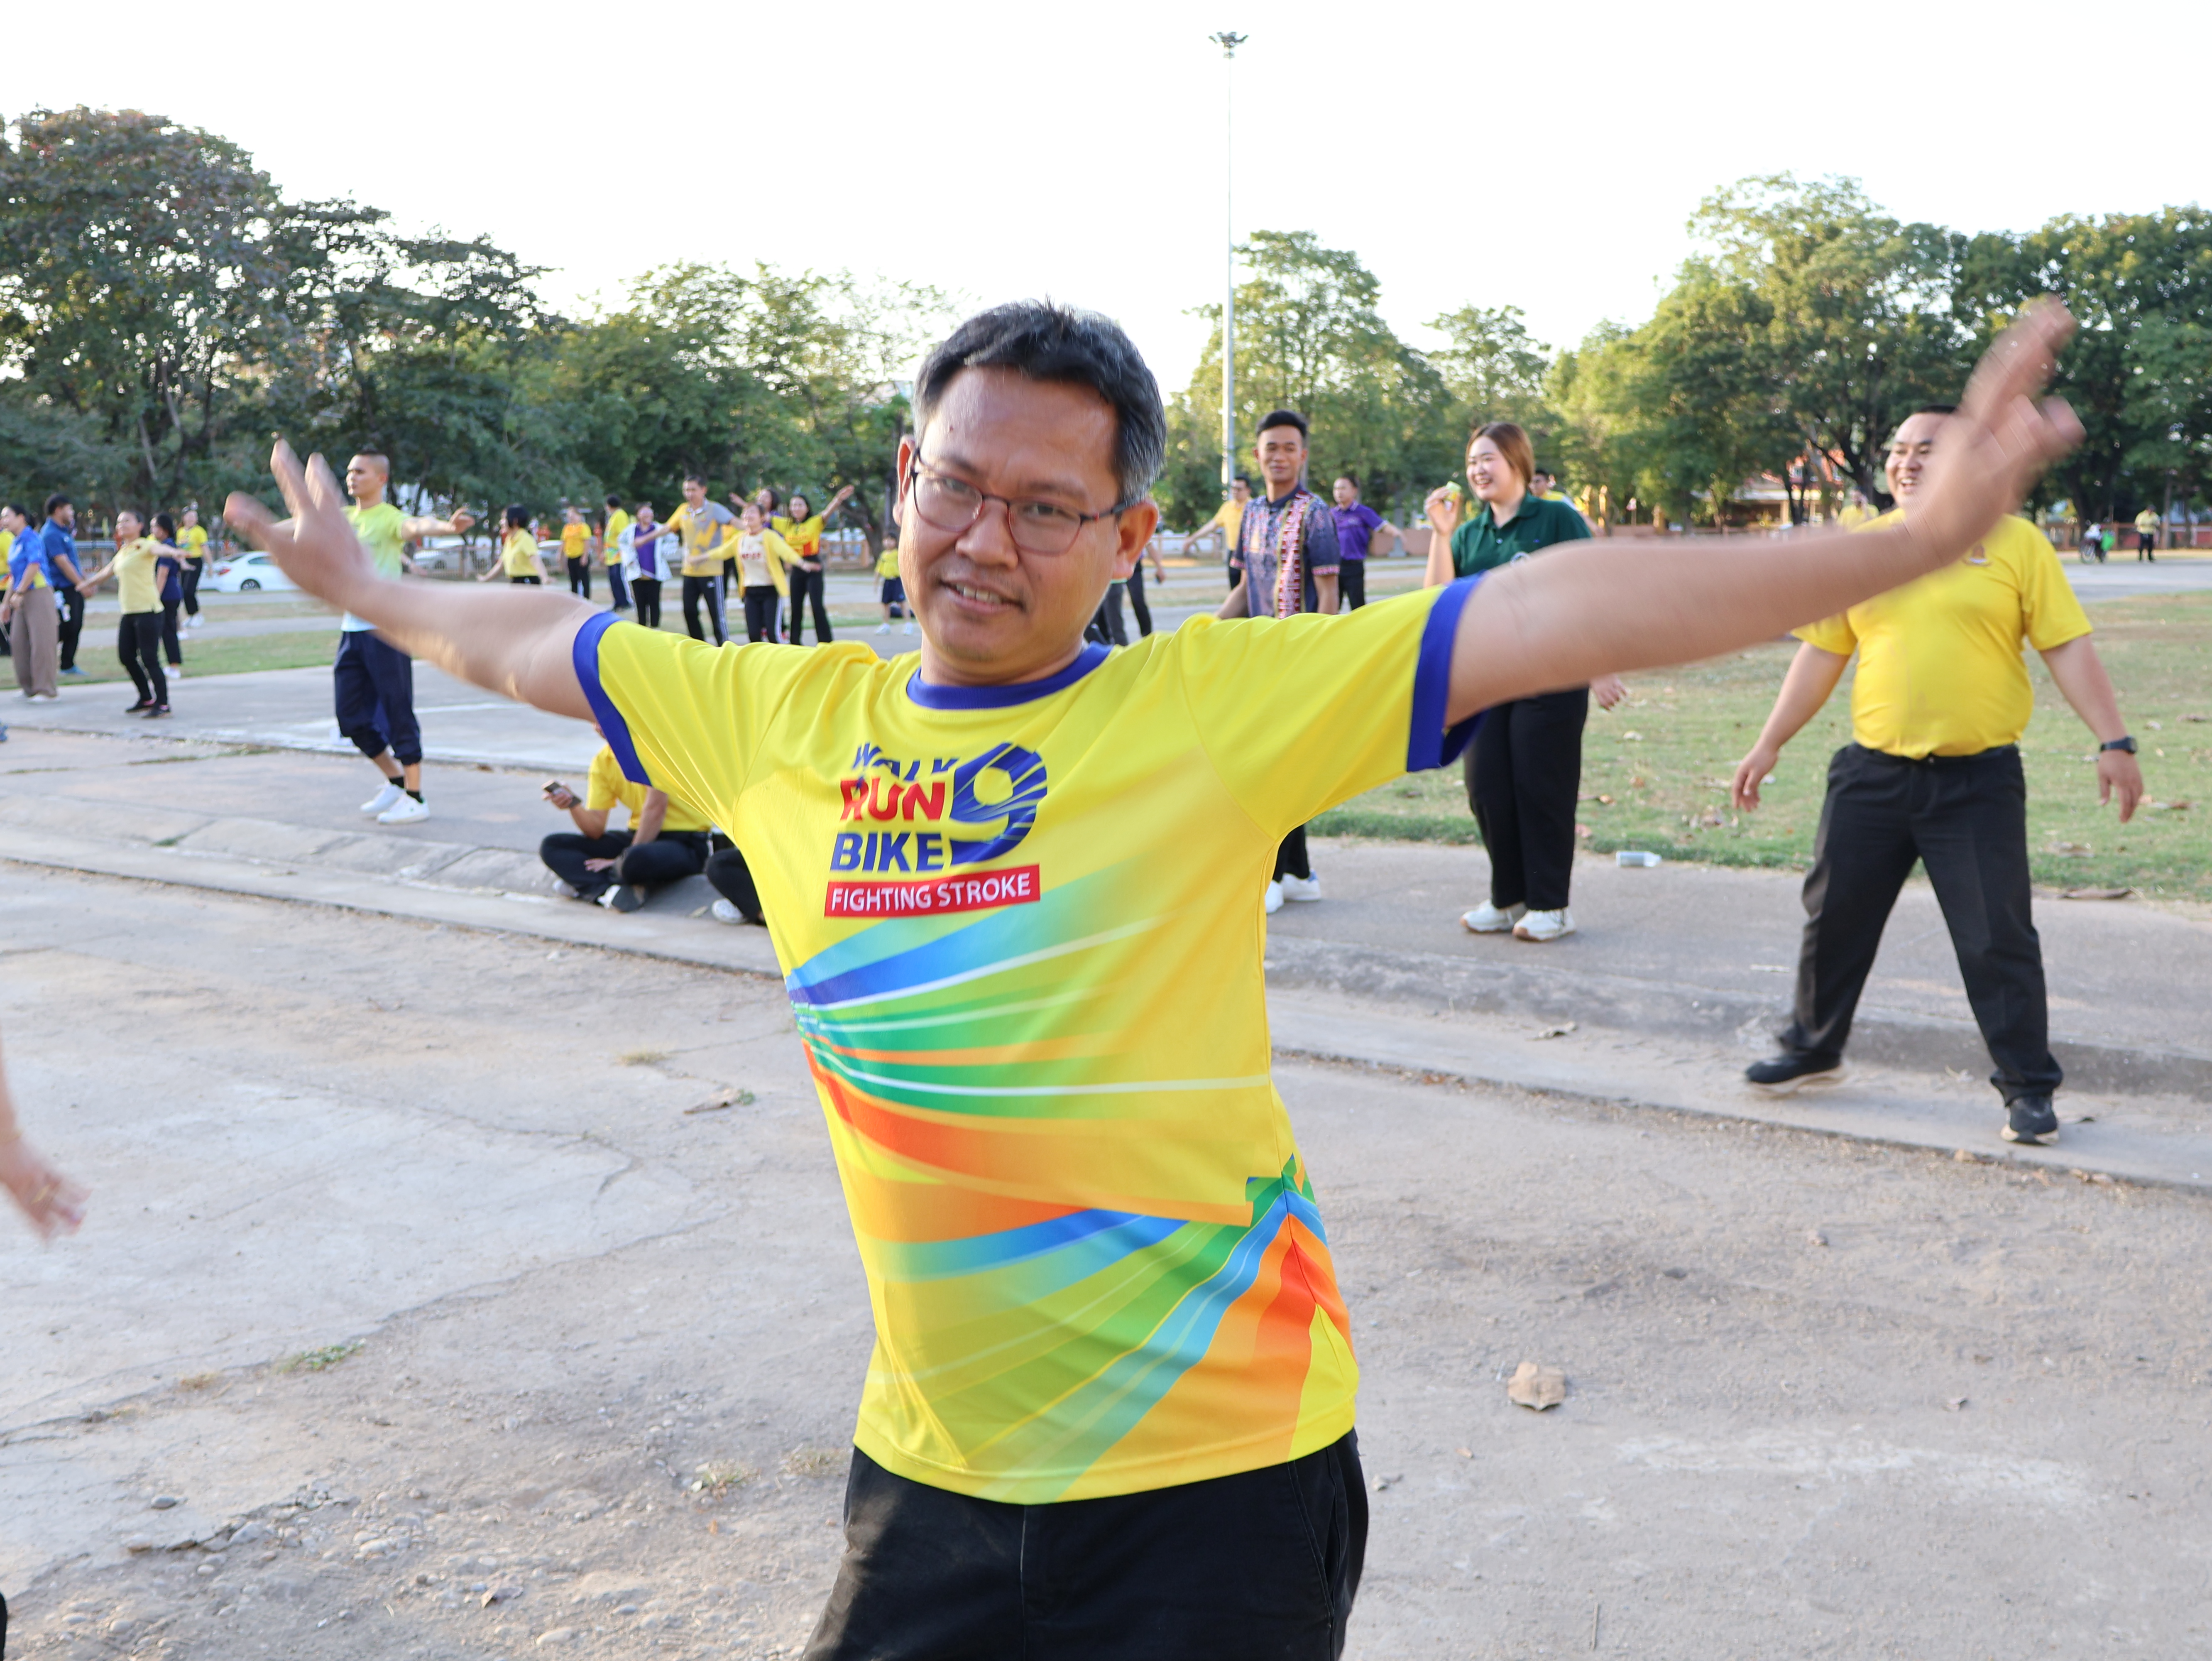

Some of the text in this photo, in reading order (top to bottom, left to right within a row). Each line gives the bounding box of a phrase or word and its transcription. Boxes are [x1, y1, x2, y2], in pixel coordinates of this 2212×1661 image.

[839, 777, 946, 822] RUN
[830, 831, 944, 872] BIKE
[831, 872, 1031, 911] FIGHTING STROKE
